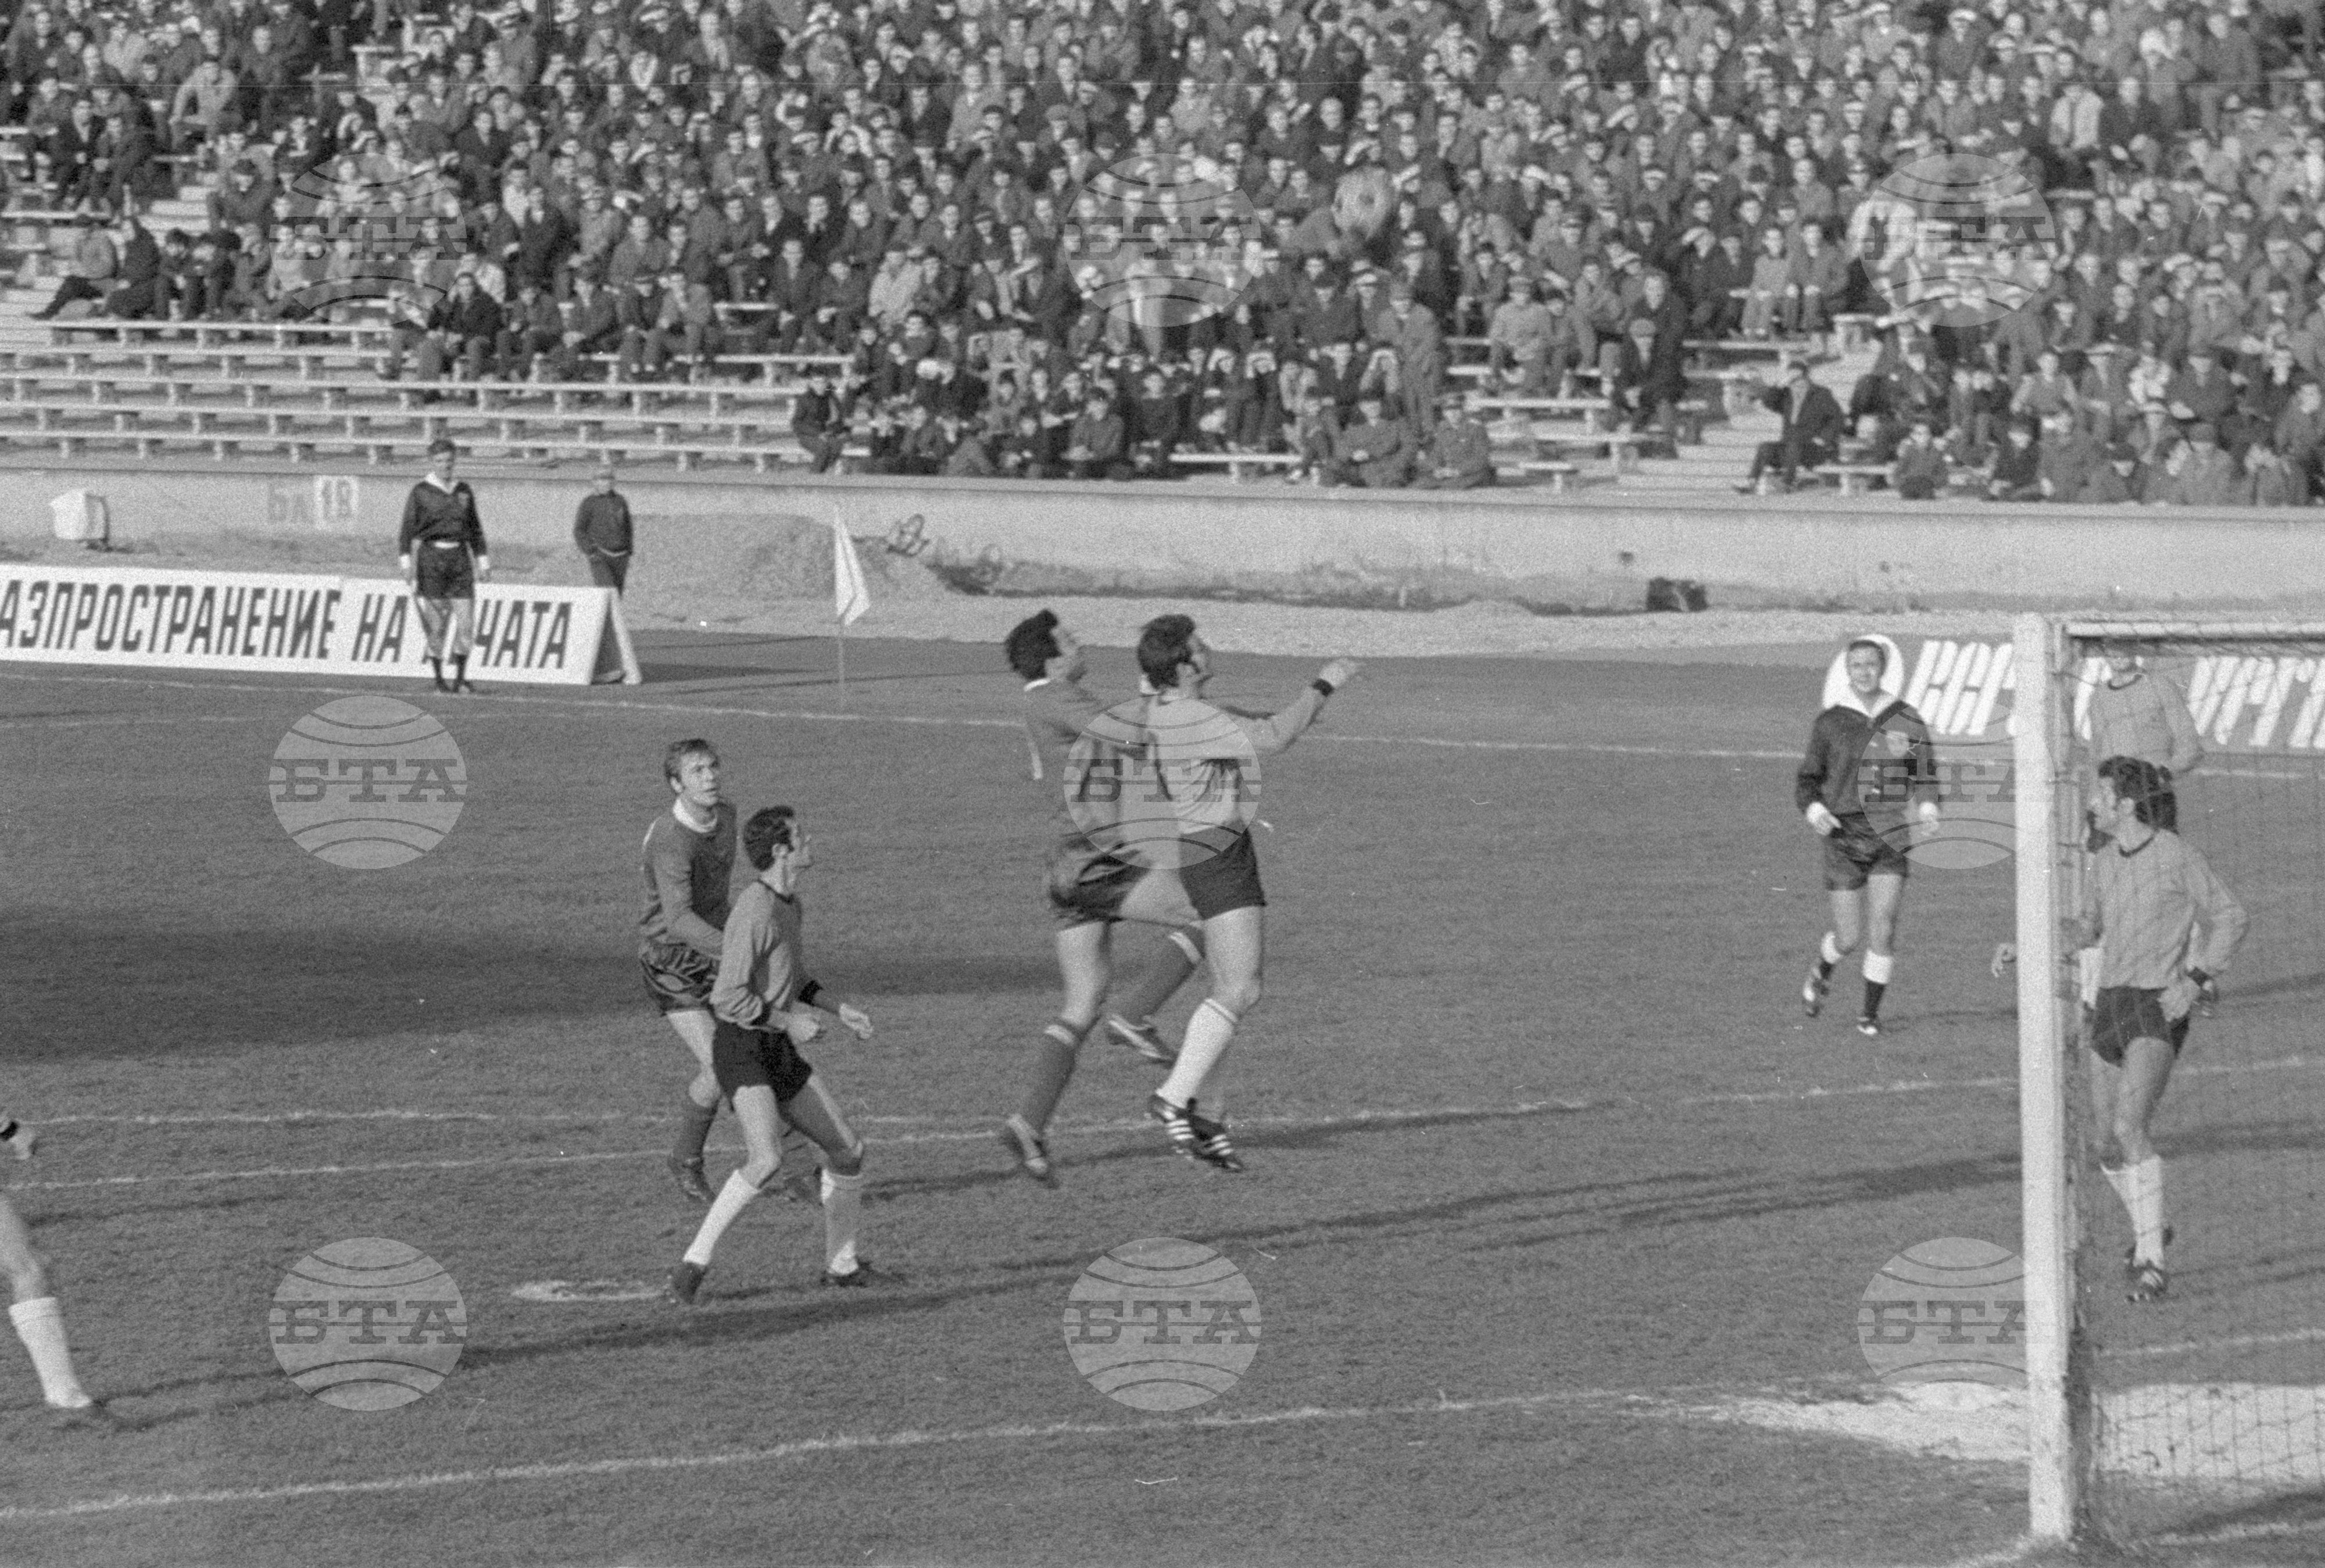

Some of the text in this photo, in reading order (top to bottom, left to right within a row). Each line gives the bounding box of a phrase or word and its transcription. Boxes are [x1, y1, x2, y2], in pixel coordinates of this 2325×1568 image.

[0, 580, 572, 670] АЗПРОСТРАНЕНИЕ НА ЧАТА
